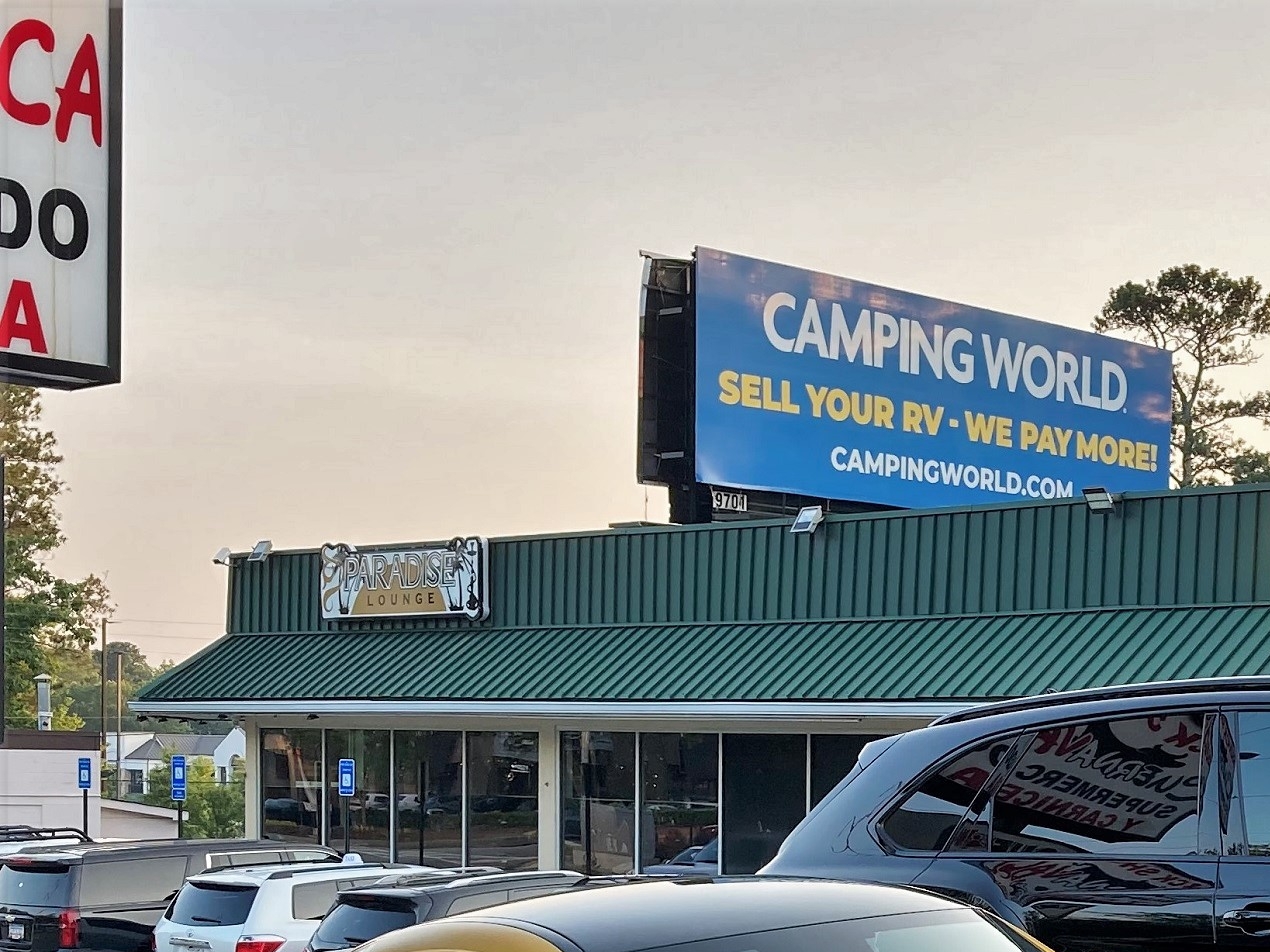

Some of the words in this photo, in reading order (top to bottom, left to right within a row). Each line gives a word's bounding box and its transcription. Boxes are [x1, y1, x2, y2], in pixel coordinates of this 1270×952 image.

[763, 292, 974, 384] CAMPING
[719, 370, 799, 414] SELL
[805, 384, 893, 429] YOUR
[903, 401, 944, 436] RV
[965, 410, 1012, 448] WE
[1021, 421, 1074, 458] PAY
[1077, 433, 1158, 473] MORE!
[831, 446, 1073, 499] CAMPINGWORLD.COM
[715, 492, 745, 510] 9701
[344, 551, 457, 591] PARADISE
[367, 592, 435, 606] LOUNGE
